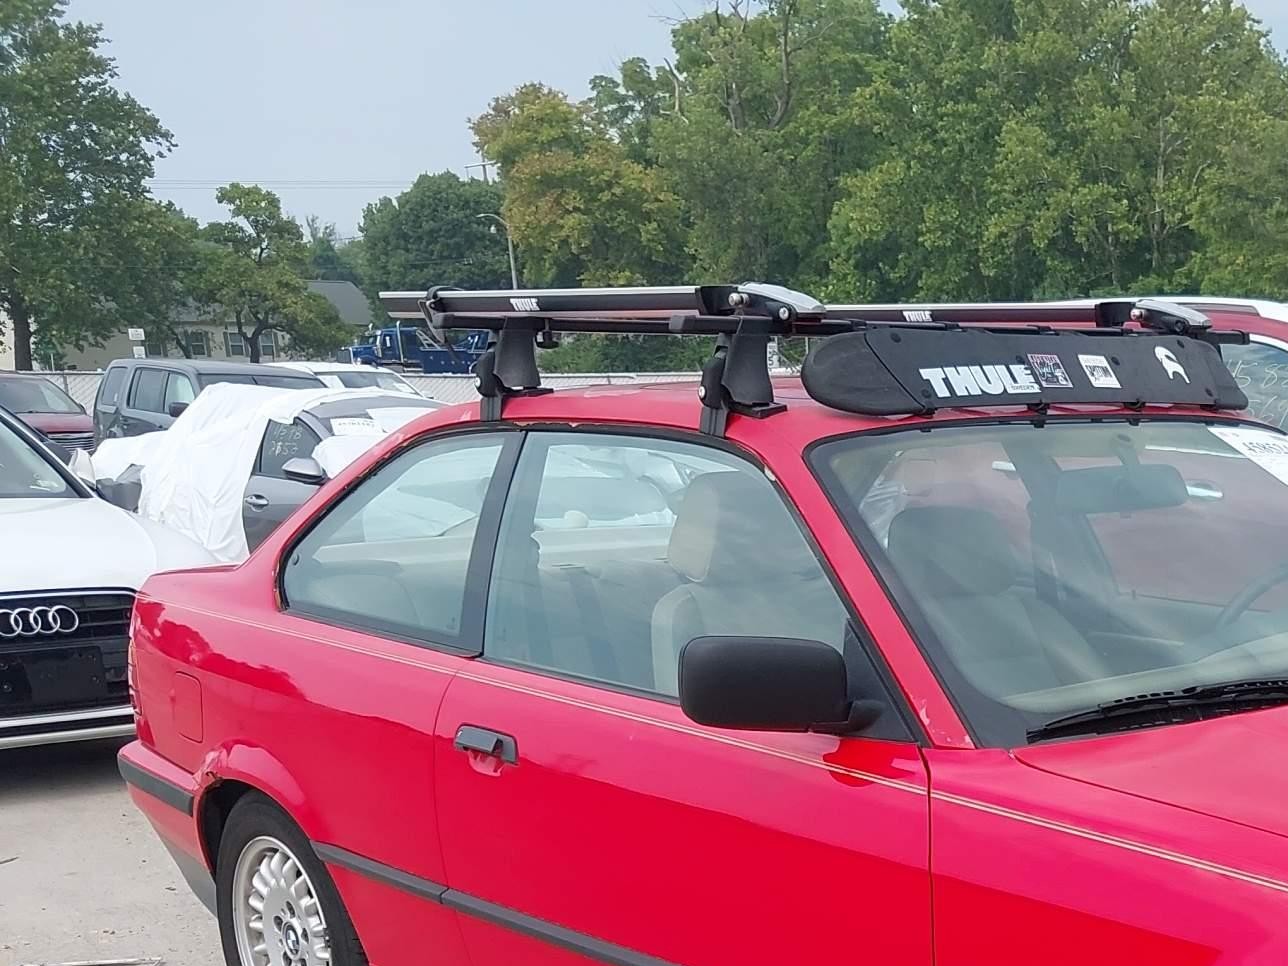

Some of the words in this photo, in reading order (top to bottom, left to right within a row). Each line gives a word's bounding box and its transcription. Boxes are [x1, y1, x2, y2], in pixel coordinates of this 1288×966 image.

[509, 298, 541, 311] THULE
[902, 310, 933, 321] THULE
[919, 364, 1041, 398] THULE
